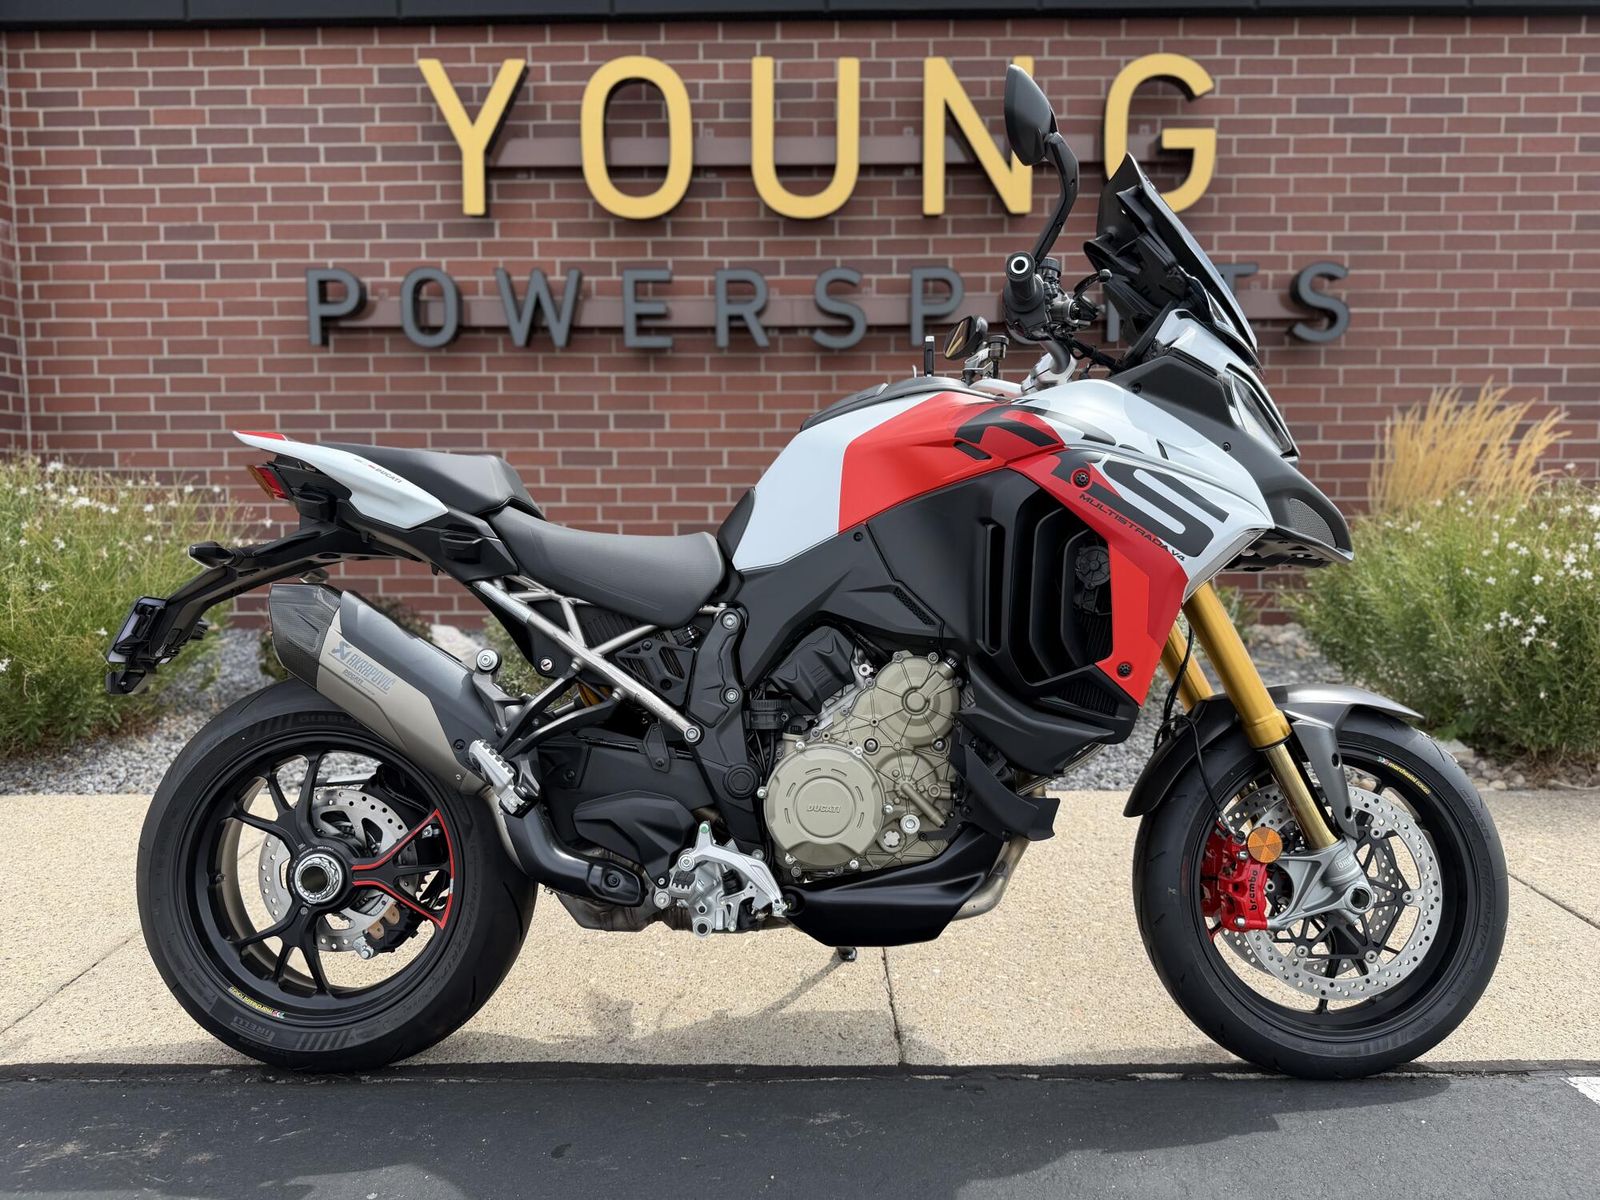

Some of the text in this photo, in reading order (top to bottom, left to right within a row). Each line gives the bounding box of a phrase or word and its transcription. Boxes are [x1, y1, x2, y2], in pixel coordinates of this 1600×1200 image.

[417, 53, 1217, 219] YOUNG
[305, 264, 1350, 349] POWERSPS
[1079, 493, 1186, 562] MULTISTRADA V4
[807, 803, 841, 814] DUCATI
[1249, 869, 1259, 911] brembo
